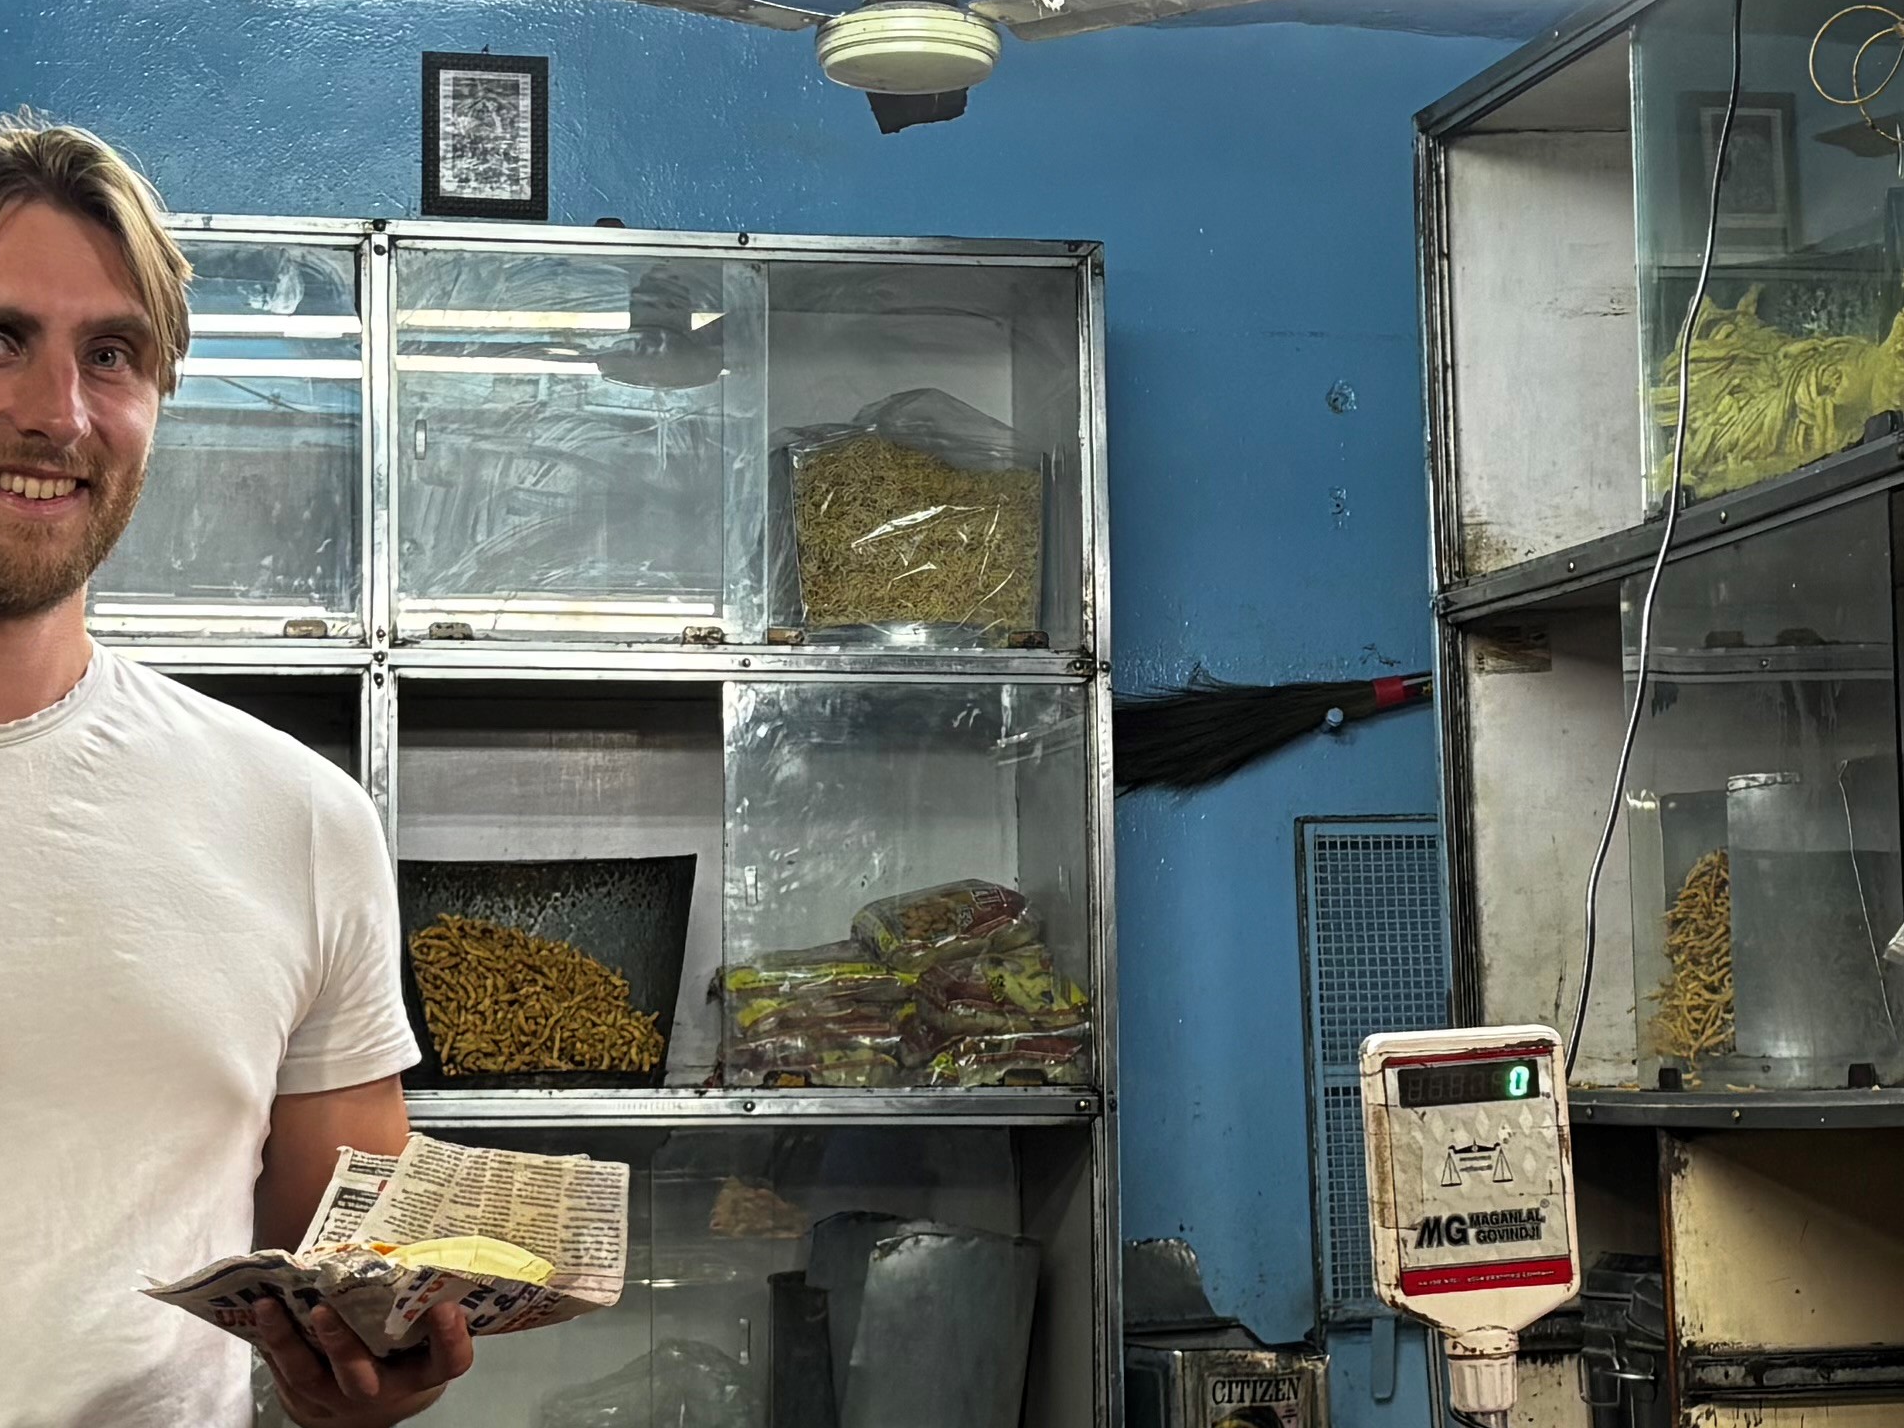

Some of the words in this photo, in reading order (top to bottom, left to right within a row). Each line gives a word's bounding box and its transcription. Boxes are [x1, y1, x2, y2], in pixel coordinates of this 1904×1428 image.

[1468, 1207, 1545, 1228] MAGANLAL
[1415, 1213, 1470, 1249] MG
[1475, 1225, 1541, 1244] GOVINDJI
[1212, 1377, 1301, 1405] CITIZEN
